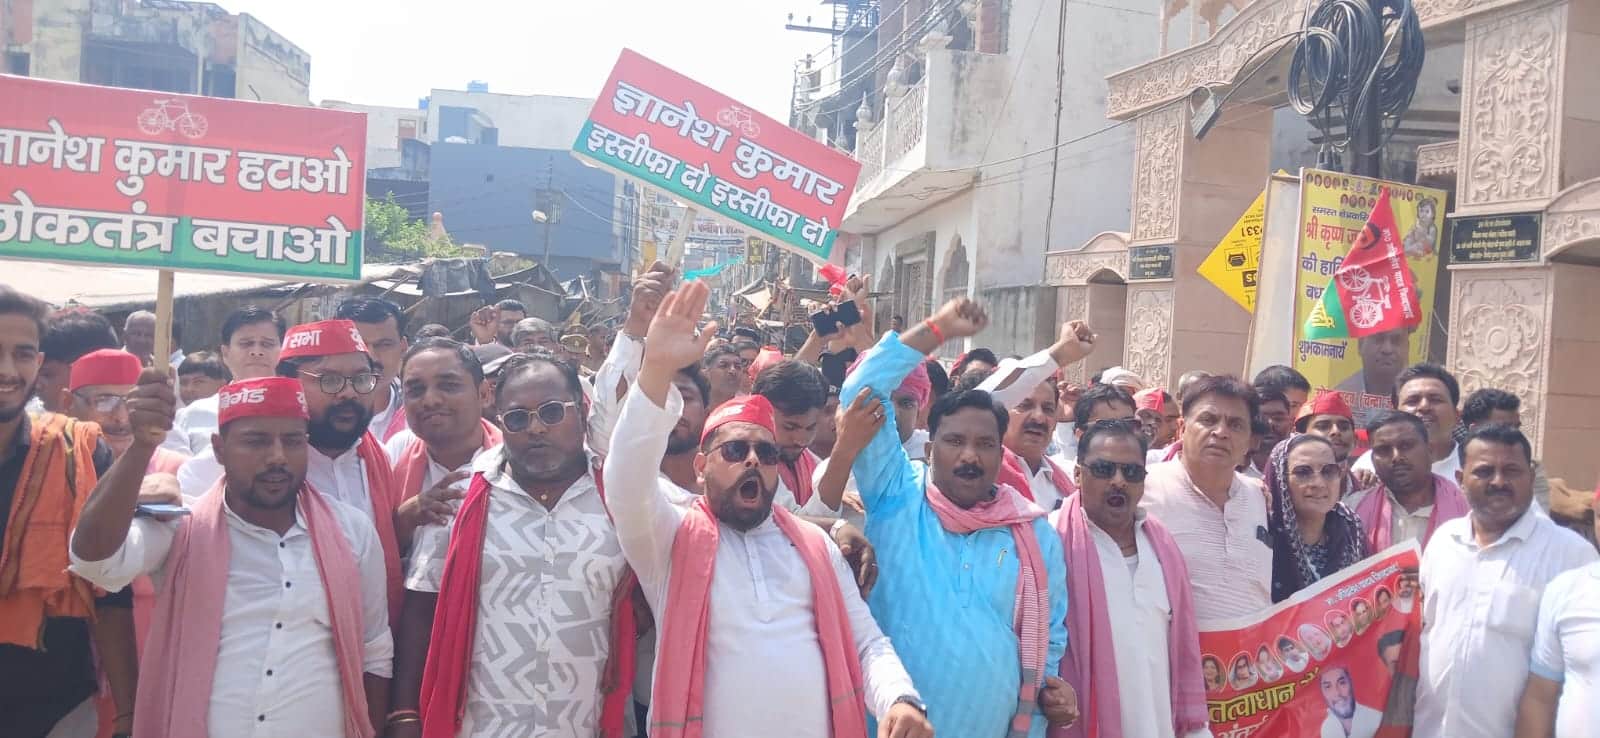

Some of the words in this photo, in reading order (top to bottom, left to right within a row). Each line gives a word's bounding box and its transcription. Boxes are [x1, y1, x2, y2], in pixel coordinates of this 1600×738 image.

[114, 138, 231, 197] कुमार
[238, 146, 352, 194] हटाओ
[612, 80, 731, 153] ज्ञानेश
[731, 136, 845, 205] कुमार
[586, 124, 680, 179] इस्तीफा
[680, 162, 712, 194] दो
[711, 176, 801, 234] इस्तीफा
[801, 217, 831, 248] दो
[191, 216, 352, 265] बचाओ
[1306, 215, 1318, 240] श्री
[1321, 224, 1345, 249] कृष्ण
[1302, 252, 1317, 272] की
